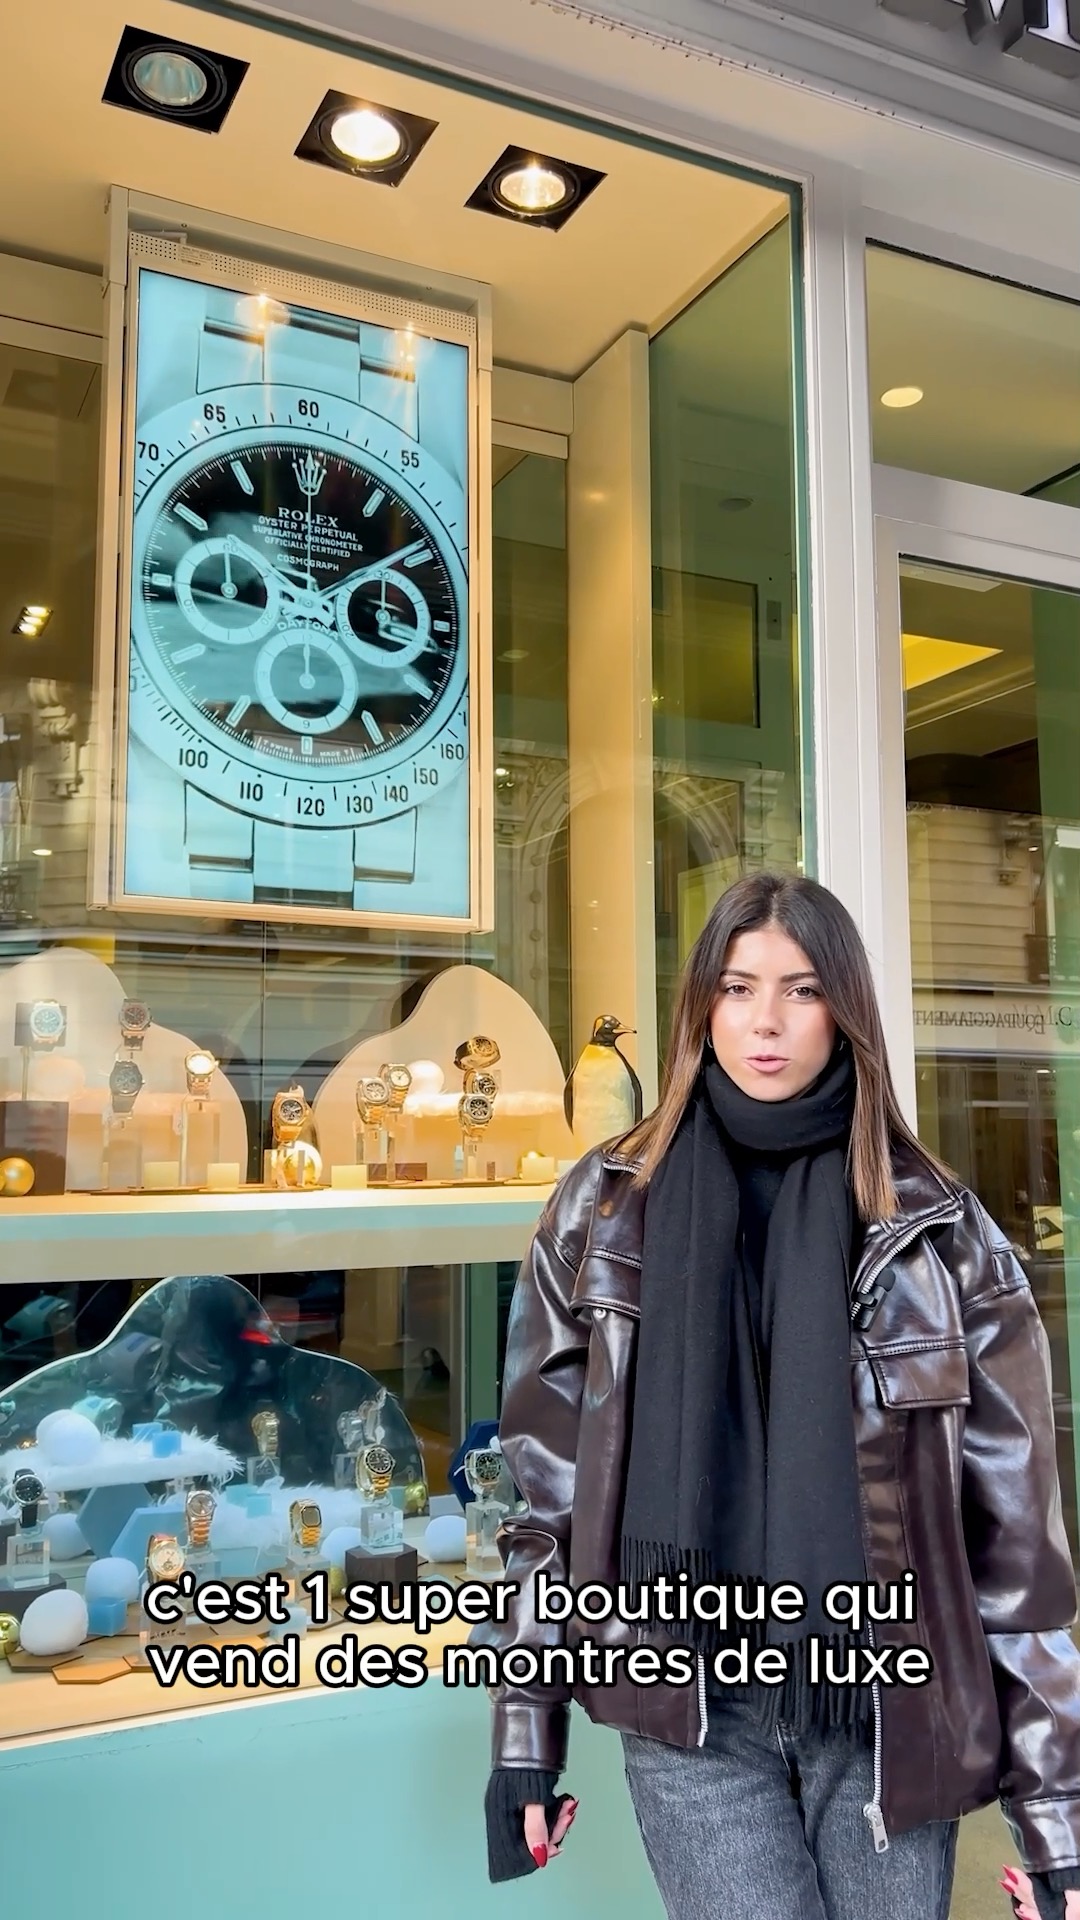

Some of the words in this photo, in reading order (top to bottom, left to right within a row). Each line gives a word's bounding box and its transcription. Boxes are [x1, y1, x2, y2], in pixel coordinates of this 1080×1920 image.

[204, 403, 225, 423] 65
[298, 399, 319, 418] 60
[137, 441, 159, 461] 70
[401, 450, 420, 468] 55
[278, 506, 338, 528] ROLEX
[252, 524, 303, 540] SUPERLATIVE
[305, 534, 363, 552] CHRONOMETER
[258, 515, 298, 530] OYSTER
[301, 523, 358, 542] PERPETUAL
[264, 536, 308, 551] OFFICIALLY
[311, 544, 351, 558] CERTIFIED
[277, 553, 340, 572] COSMOGRAPH
[277, 618, 339, 640] DAYTONA
[179, 748, 208, 769] 100
[441, 743, 465, 760] 160
[413, 767, 439, 786] 150
[240, 781, 264, 802] 110
[384, 785, 409, 803] 140
[297, 796, 325, 817] 120
[347, 795, 373, 814] 130
